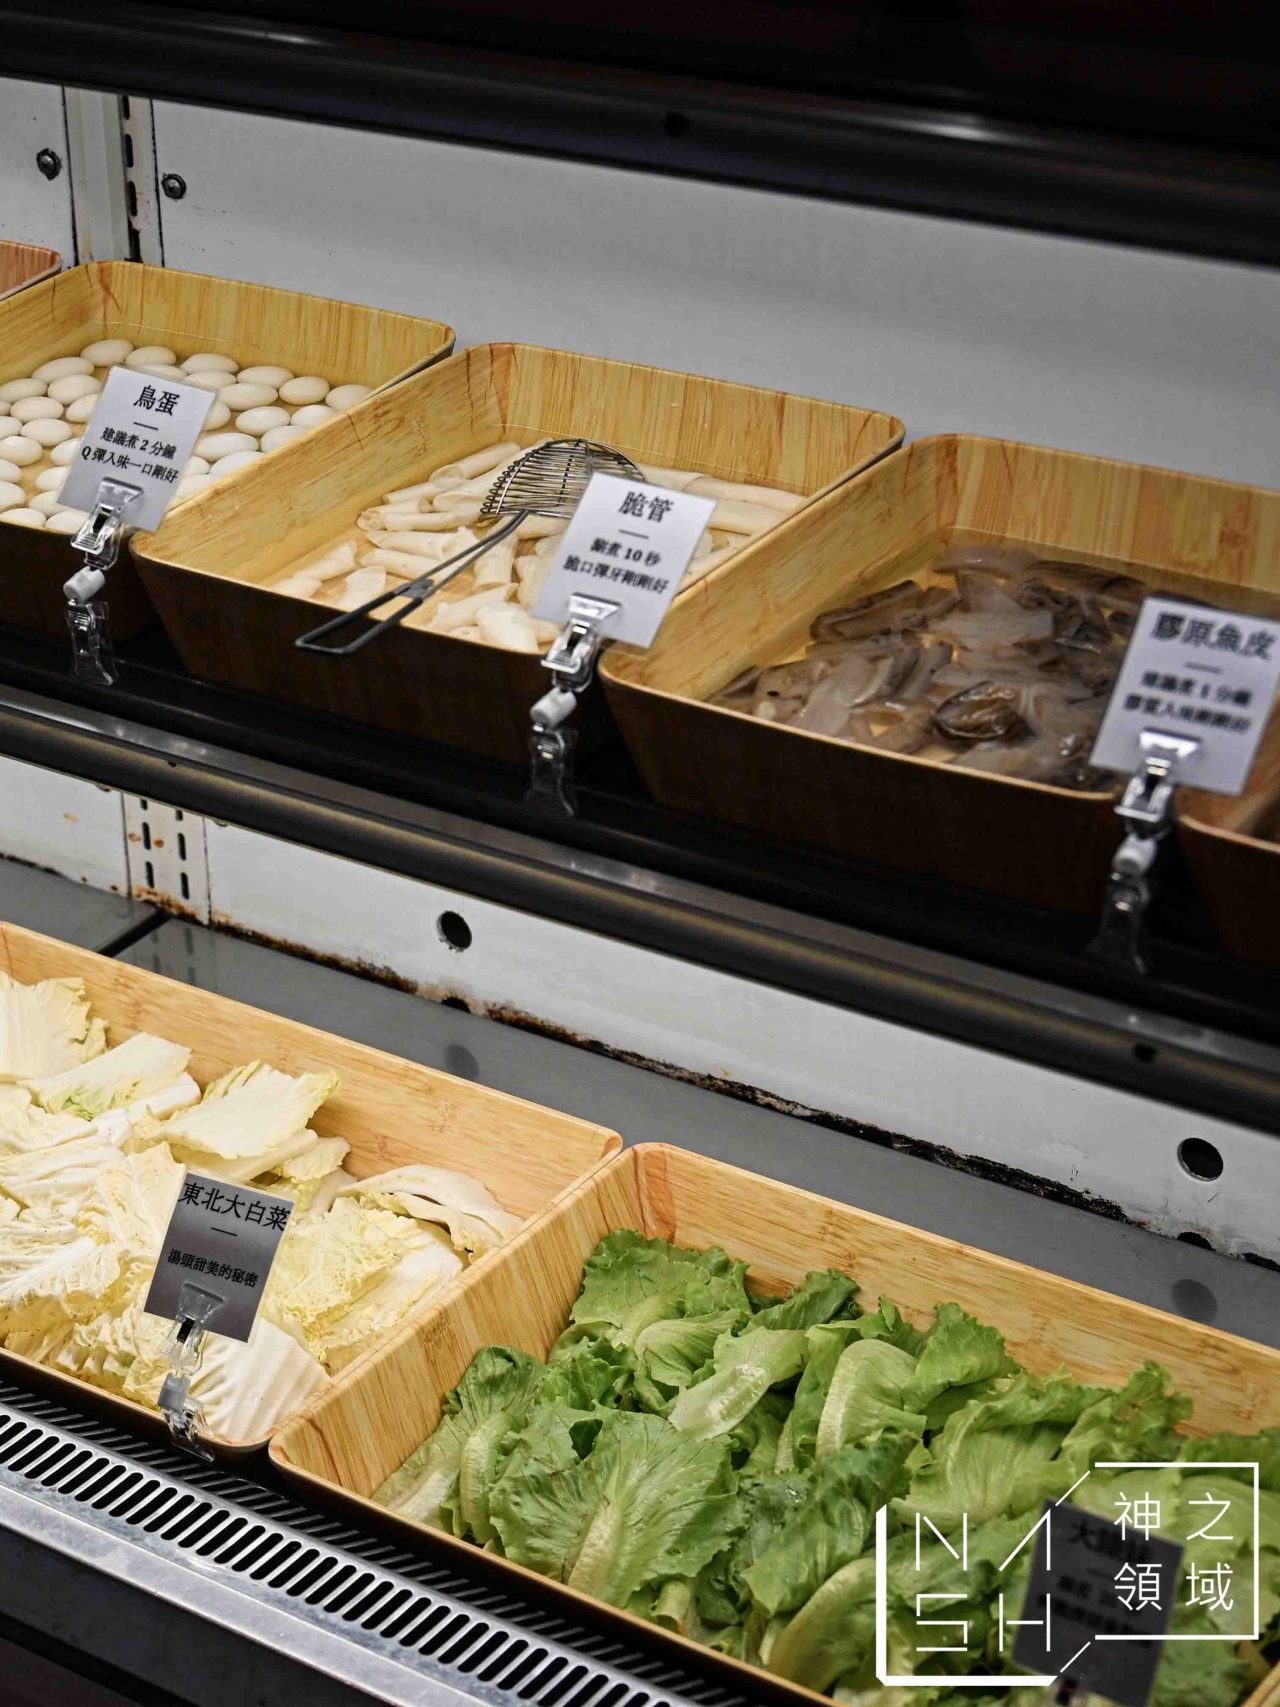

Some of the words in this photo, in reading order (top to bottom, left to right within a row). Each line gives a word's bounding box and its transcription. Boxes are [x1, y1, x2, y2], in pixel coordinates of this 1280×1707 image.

[133, 385, 180, 416] 鳥蛋
[101, 427, 139, 449] 建議煮
[140, 440, 149, 451] 2
[149, 441, 177, 460] 分鐘
[81, 446, 91, 460] Q
[92, 447, 179, 483] 彈入味一口剛好
[619, 491, 674, 523] 脆管
[624, 548, 642, 561] 10
[645, 551, 661, 567] 秒
[1151, 611, 1276, 661] 膠原魚皮
[177, 1182, 290, 1232] 東北大白菜
[167, 1248, 259, 1288] 湯頭甜美的秘密
